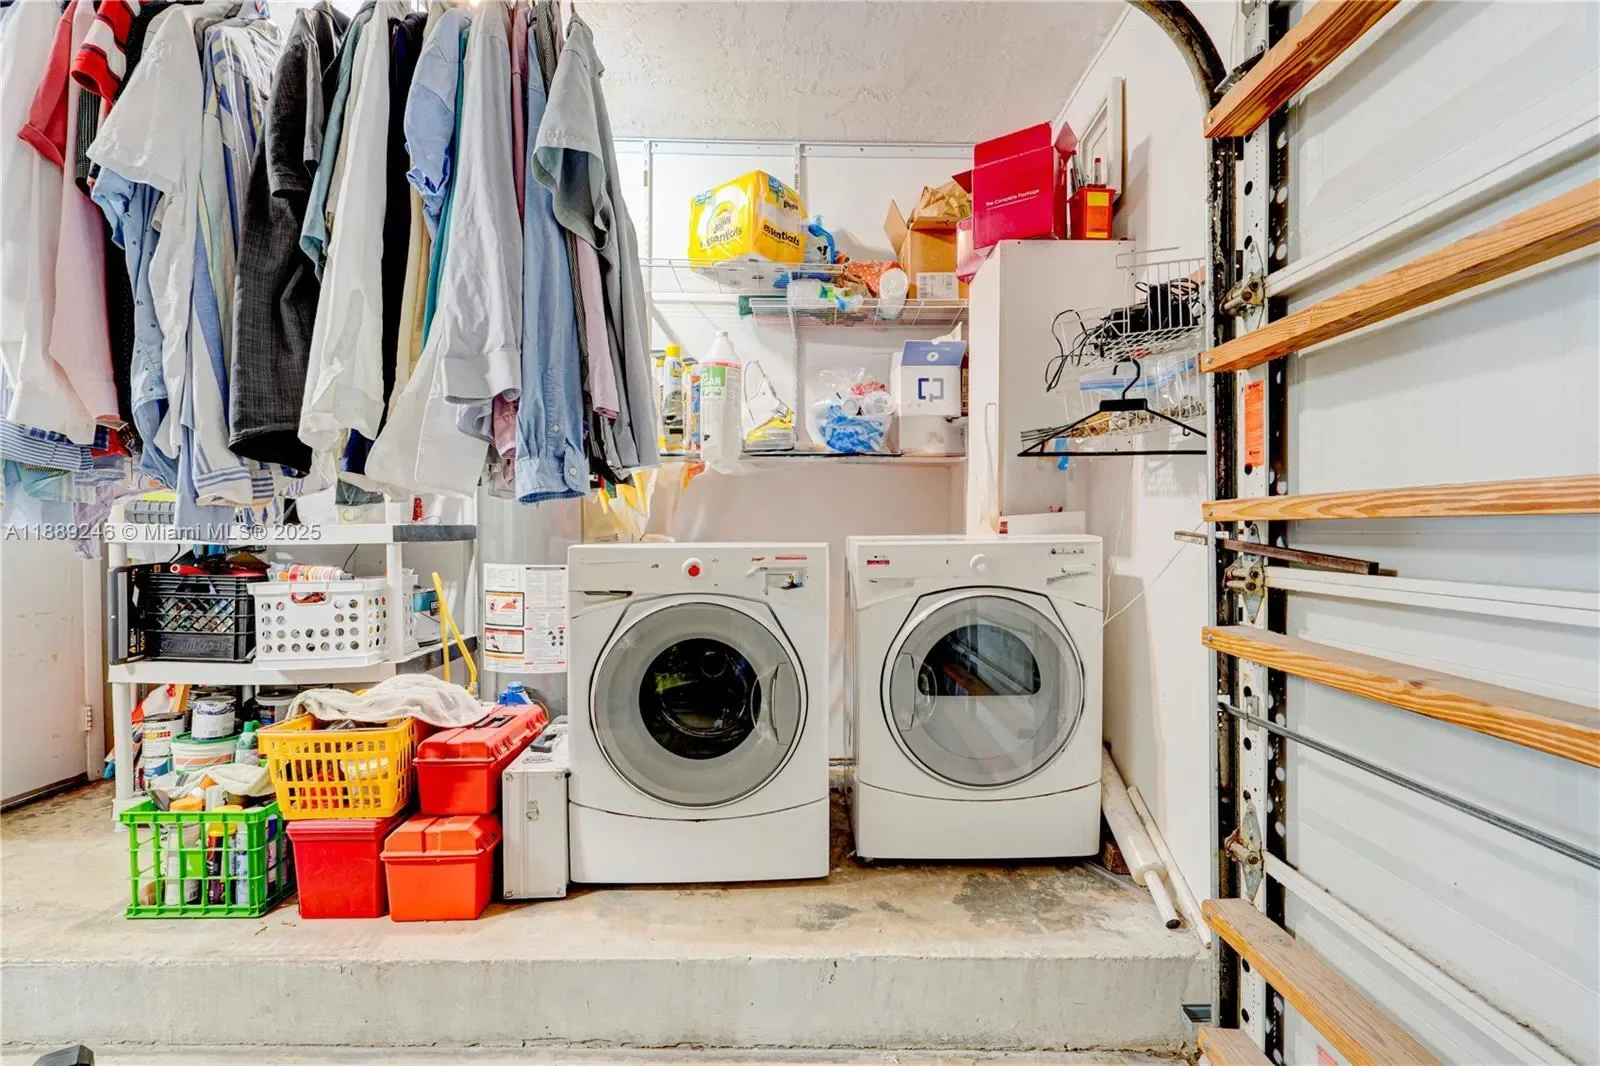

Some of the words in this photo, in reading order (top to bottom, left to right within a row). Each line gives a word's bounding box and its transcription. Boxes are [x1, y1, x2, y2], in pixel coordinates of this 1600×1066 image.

[994, 195, 1017, 205] Complete
[1017, 188, 1040, 199] Package
[763, 224, 800, 246] essentials
